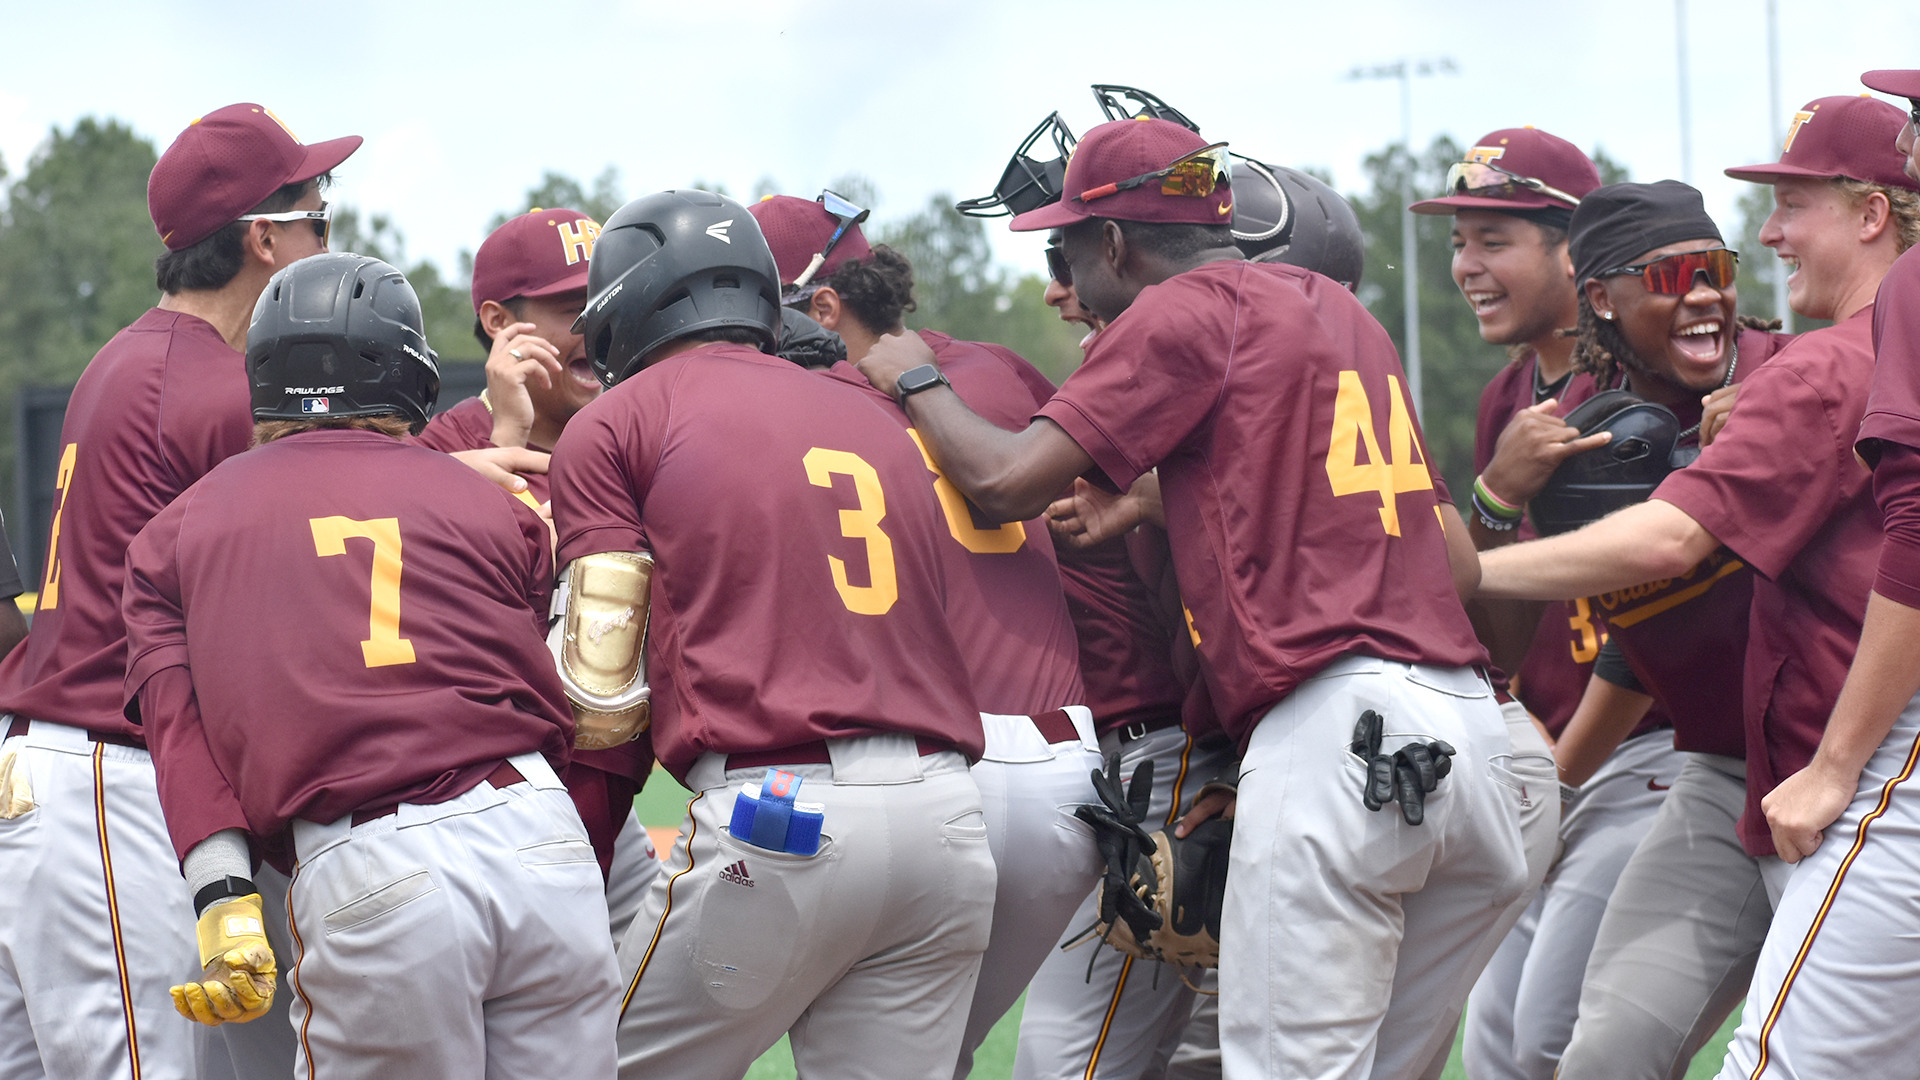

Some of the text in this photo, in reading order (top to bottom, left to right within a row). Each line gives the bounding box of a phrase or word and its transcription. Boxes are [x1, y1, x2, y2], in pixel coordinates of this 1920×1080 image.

[1783, 110, 1815, 153] T
[597, 283, 623, 312] EASTON
[284, 385, 345, 395] RAWLINGS
[1325, 370, 1447, 541] 44
[802, 446, 898, 615] 3
[309, 515, 417, 668] 7
[1567, 598, 1609, 664] 3
[718, 870, 755, 888] adidas
